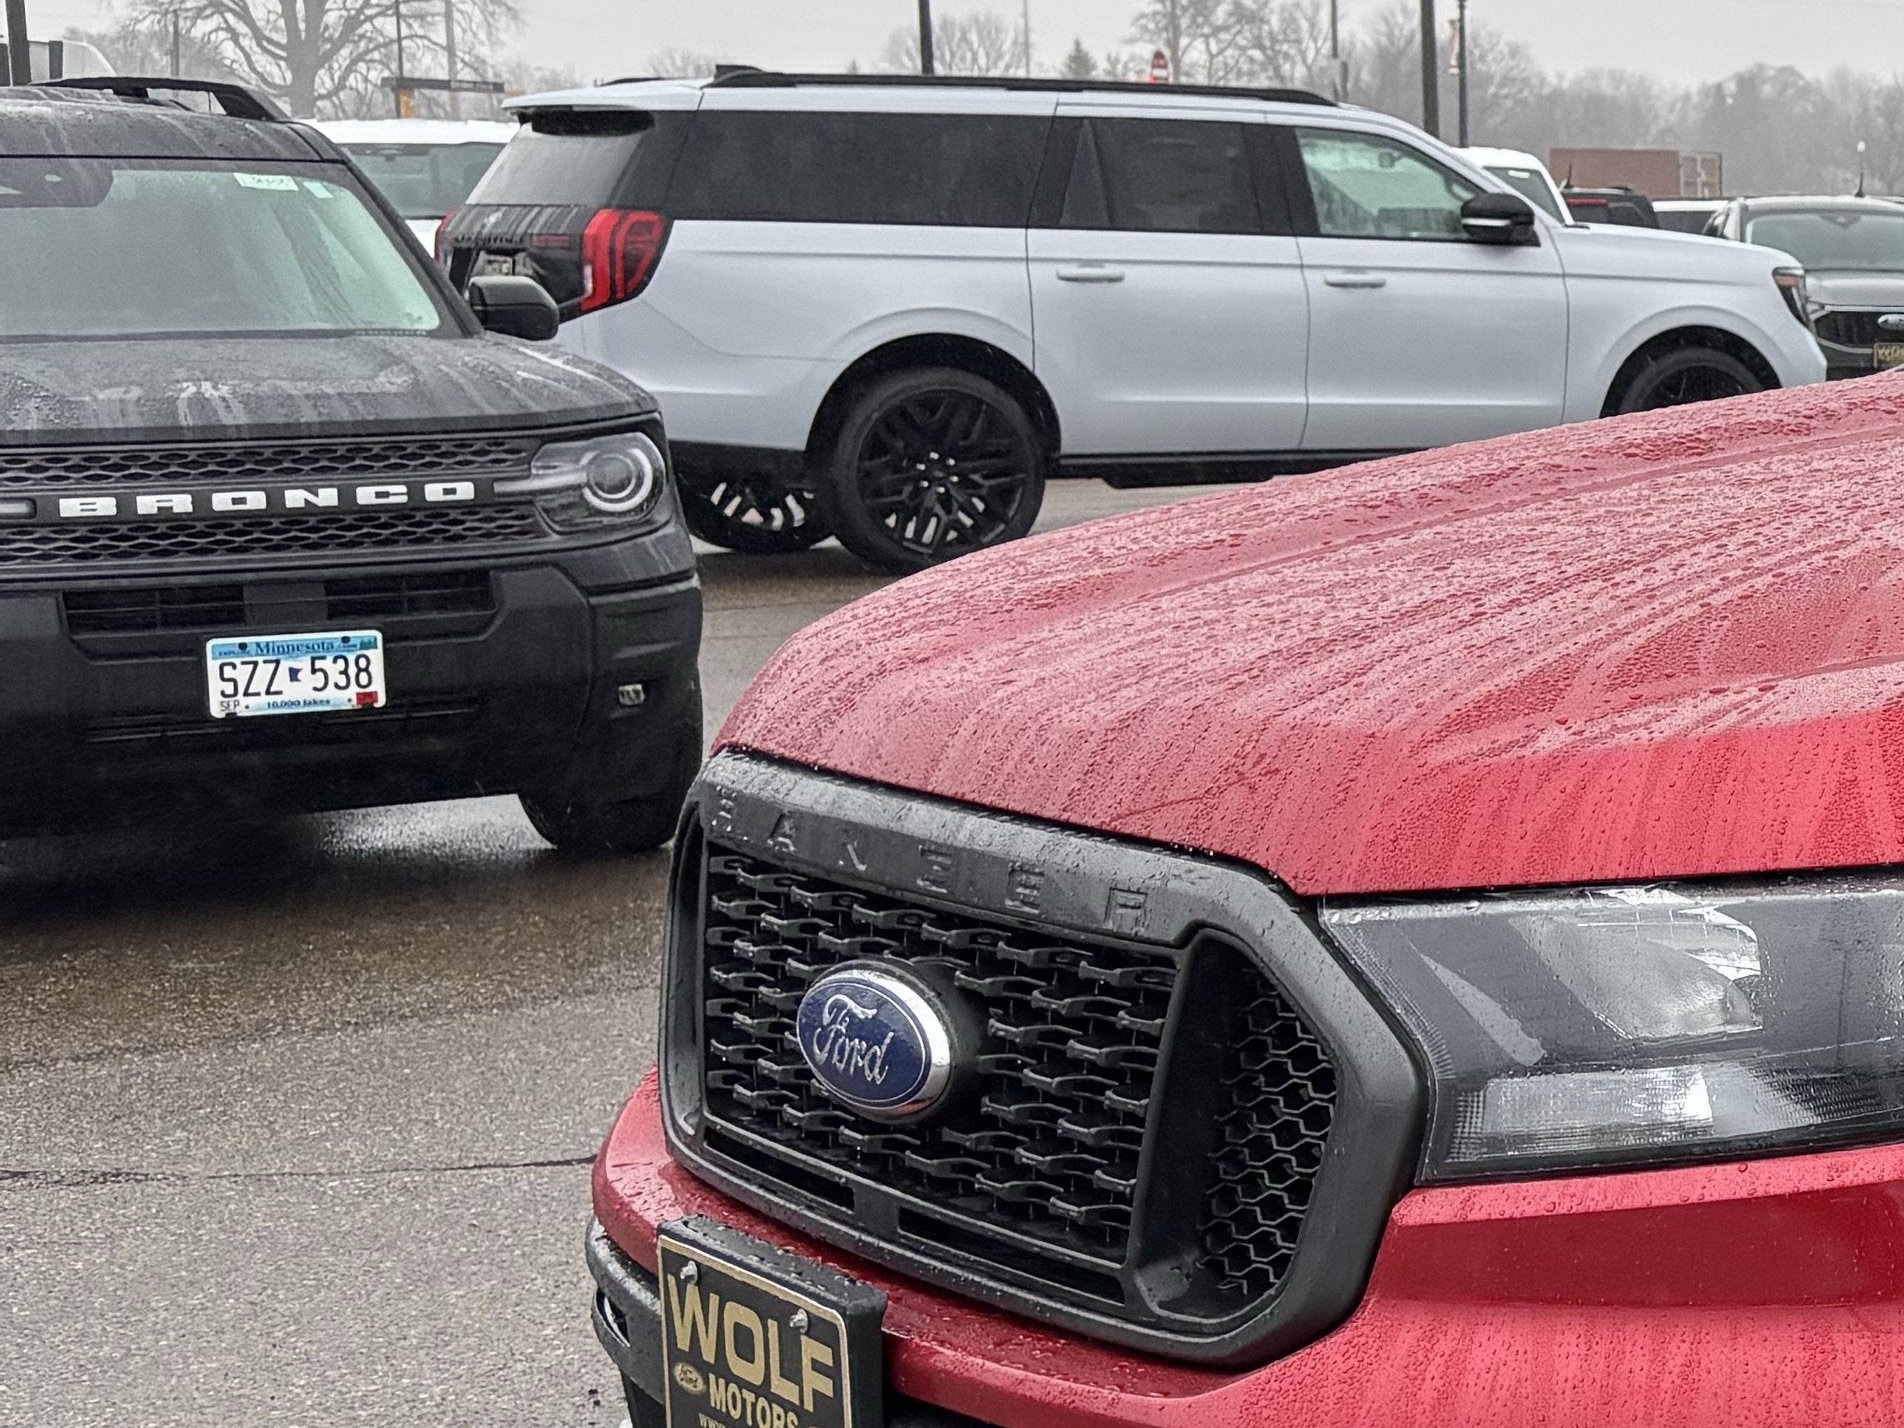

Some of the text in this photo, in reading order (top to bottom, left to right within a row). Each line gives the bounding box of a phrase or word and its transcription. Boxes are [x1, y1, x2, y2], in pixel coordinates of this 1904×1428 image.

[59, 481, 475, 517] BRONCO
[255, 640, 335, 655] Minnesota
[219, 653, 372, 699] SZZ 538
[219, 699, 240, 712] SEP
[814, 993, 895, 1085] Ford
[667, 1274, 834, 1412] WOLF
